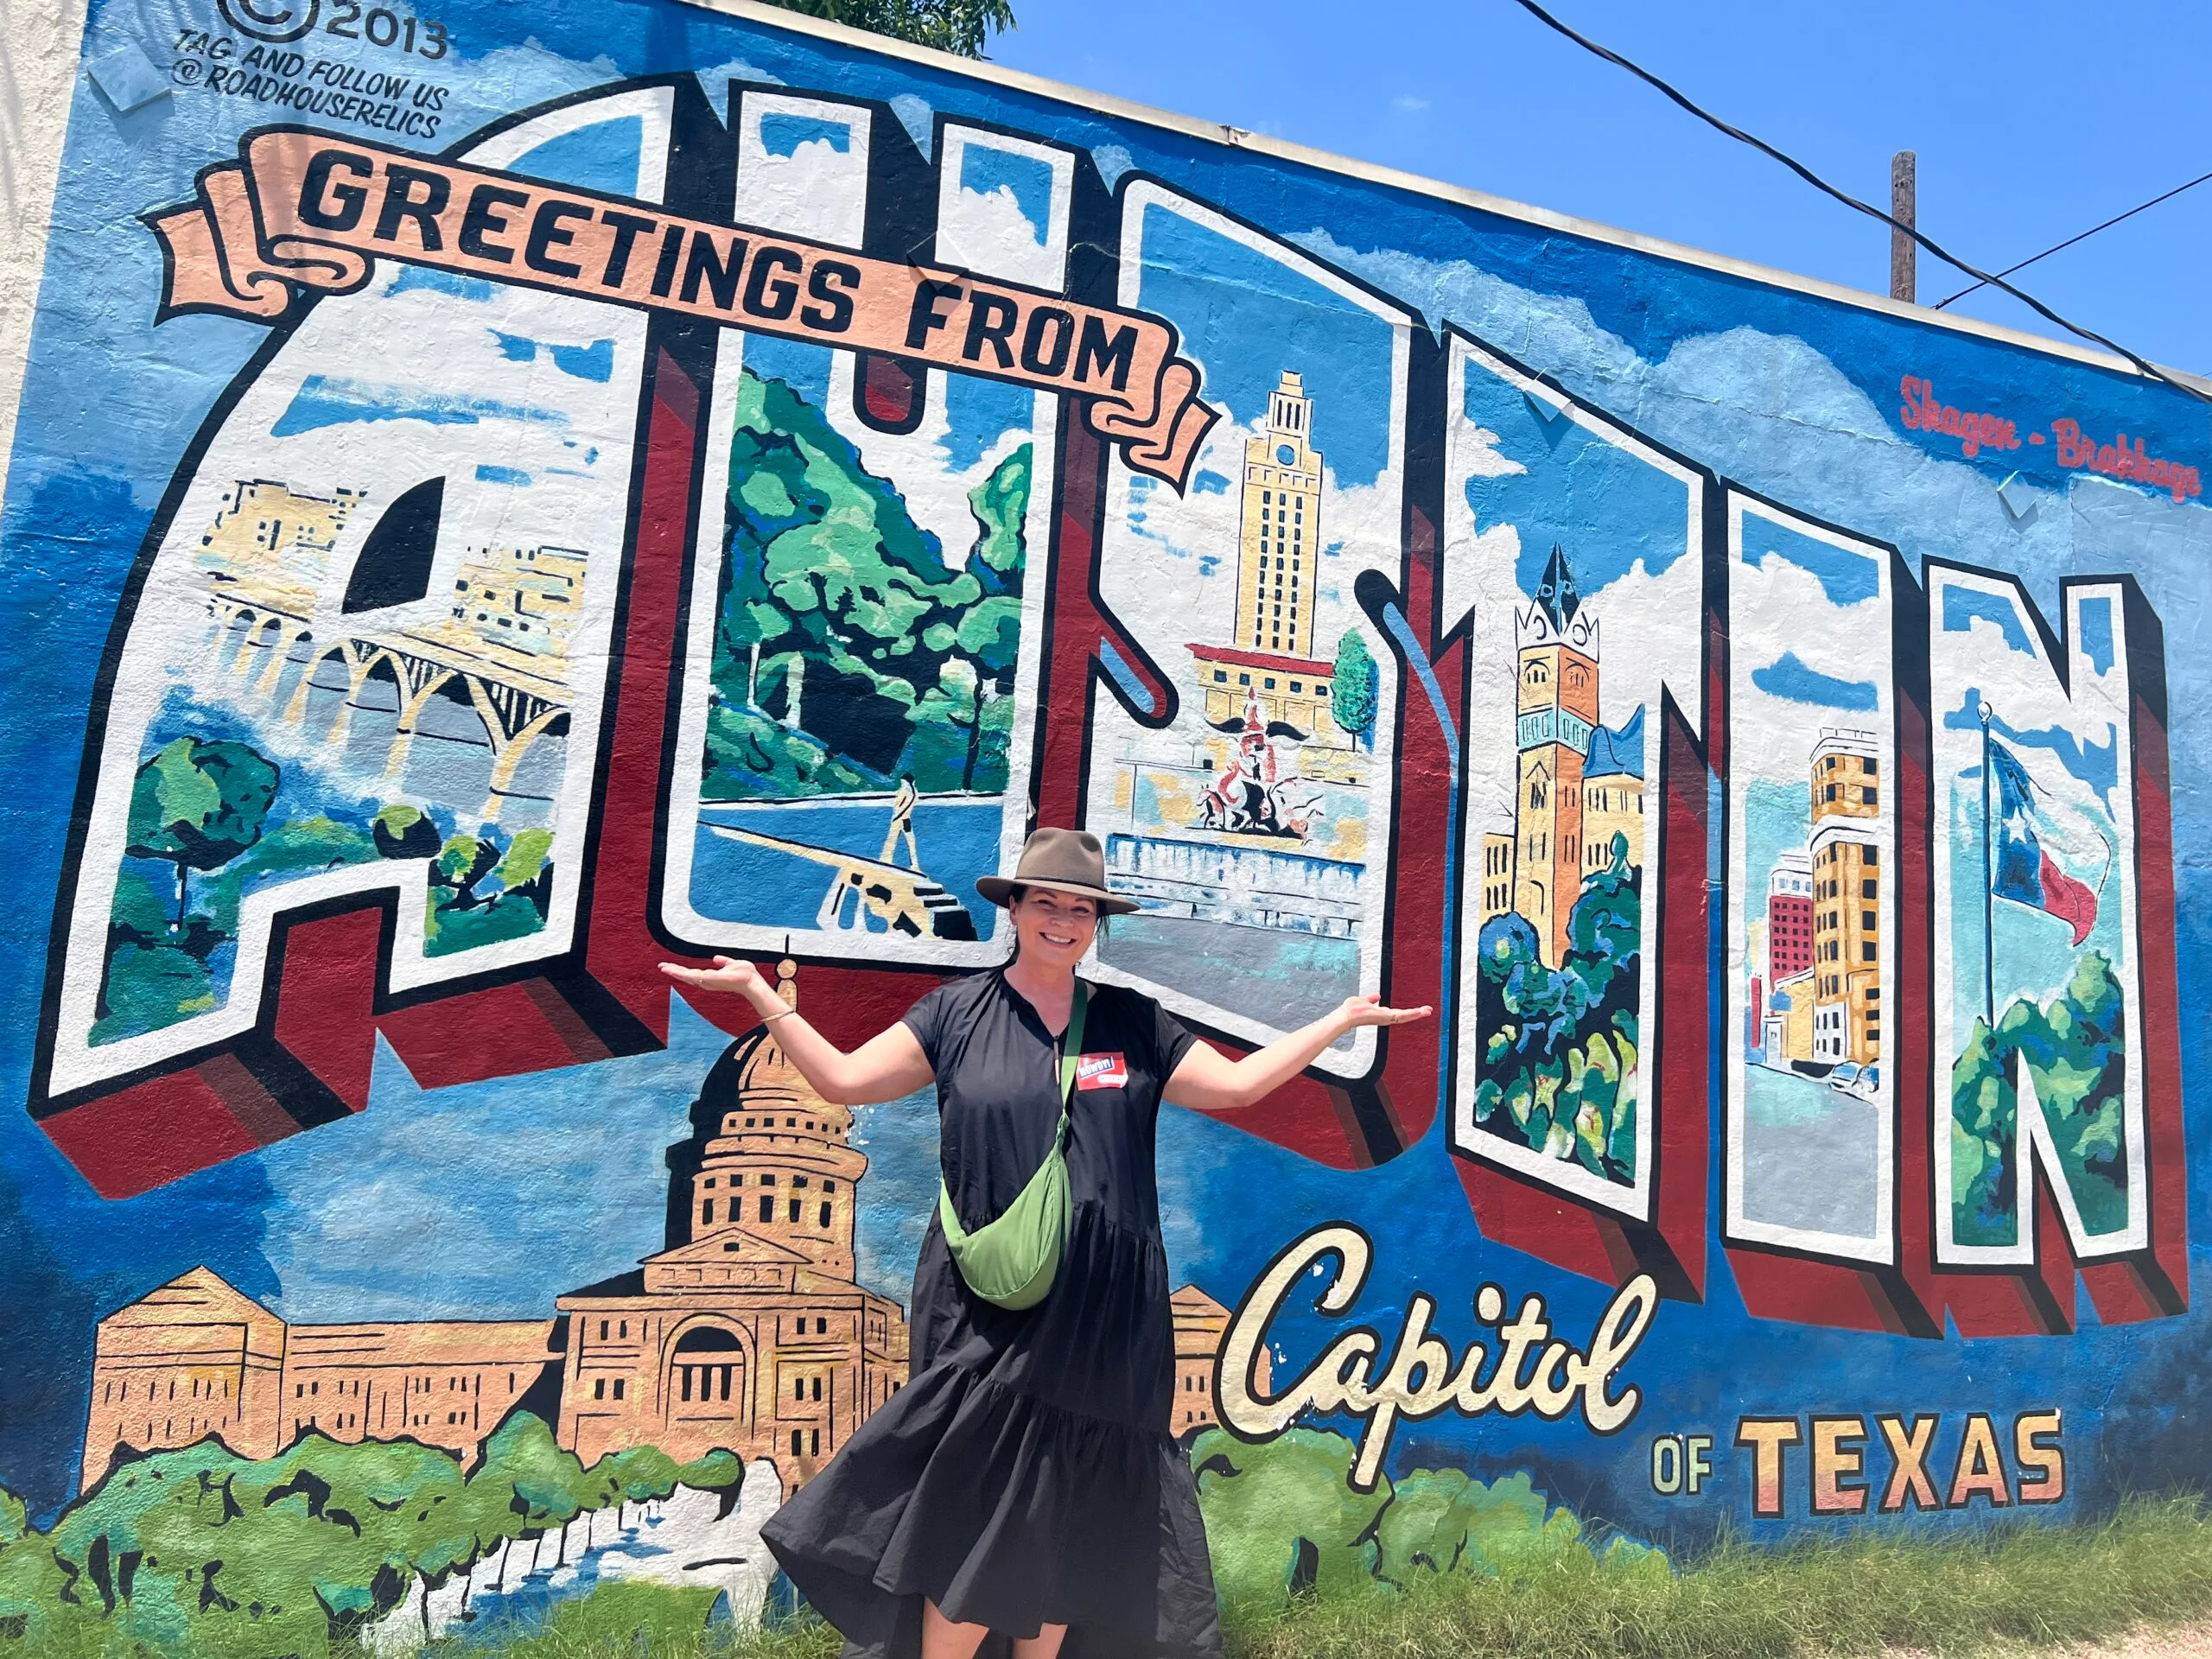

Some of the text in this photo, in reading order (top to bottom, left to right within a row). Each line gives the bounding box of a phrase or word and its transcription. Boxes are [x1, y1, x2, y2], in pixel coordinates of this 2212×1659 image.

[172, 29, 450, 111] TAG AND FOLLOW US
[326, 0, 448, 60] 2013
[173, 57, 442, 139] @ROADHOUSERELICS
[296, 147, 1139, 392] GREETINGS FROM
[31, 71, 2152, 1270] AUSTIN
[1215, 1219, 1659, 1496] Capitol
[1649, 1408, 2067, 1520] OF TEXAS
